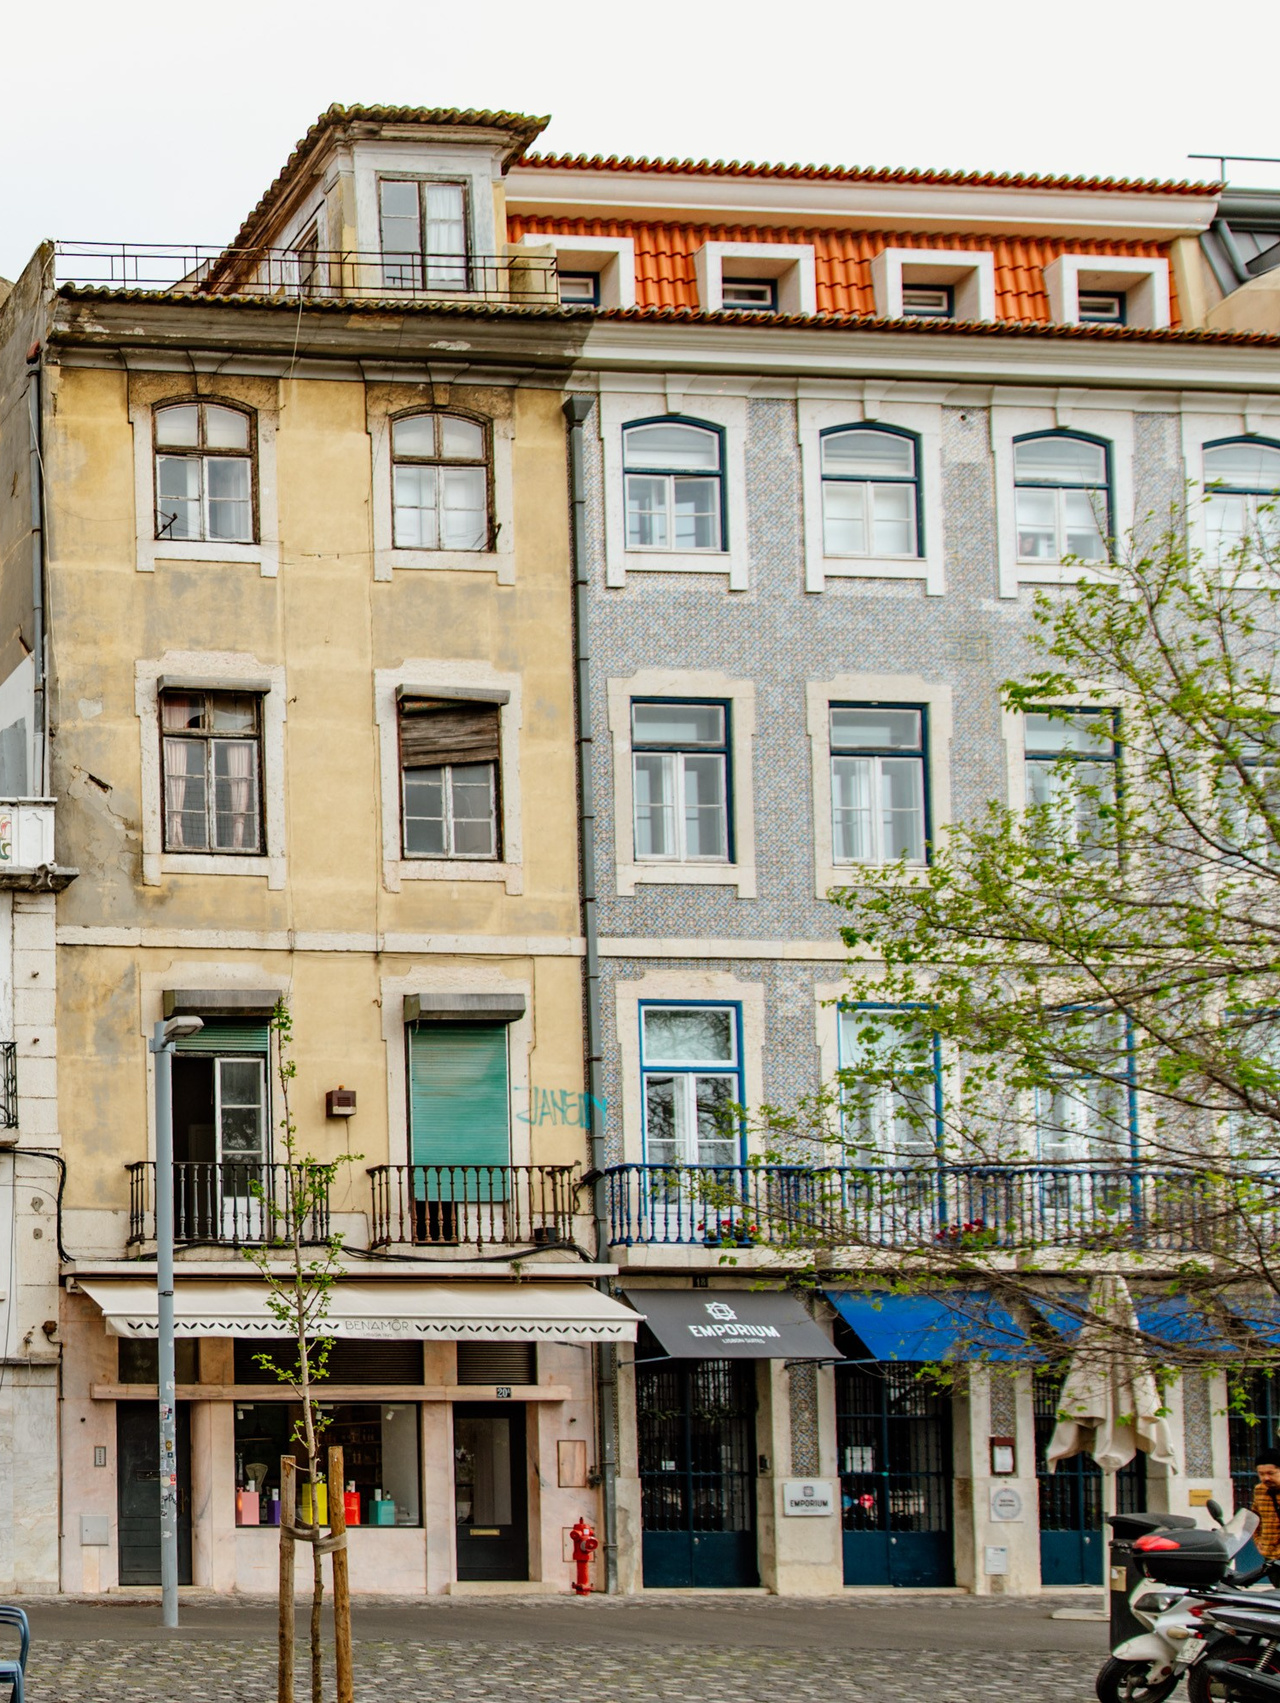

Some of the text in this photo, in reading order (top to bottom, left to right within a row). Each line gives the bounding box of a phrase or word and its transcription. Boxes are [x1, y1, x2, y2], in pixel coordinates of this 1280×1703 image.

[345, 1318, 409, 1332] BENAMÔR
[688, 1323, 781, 1338] EMPORIUM
[790, 1499, 828, 1507] EMPORIUM
